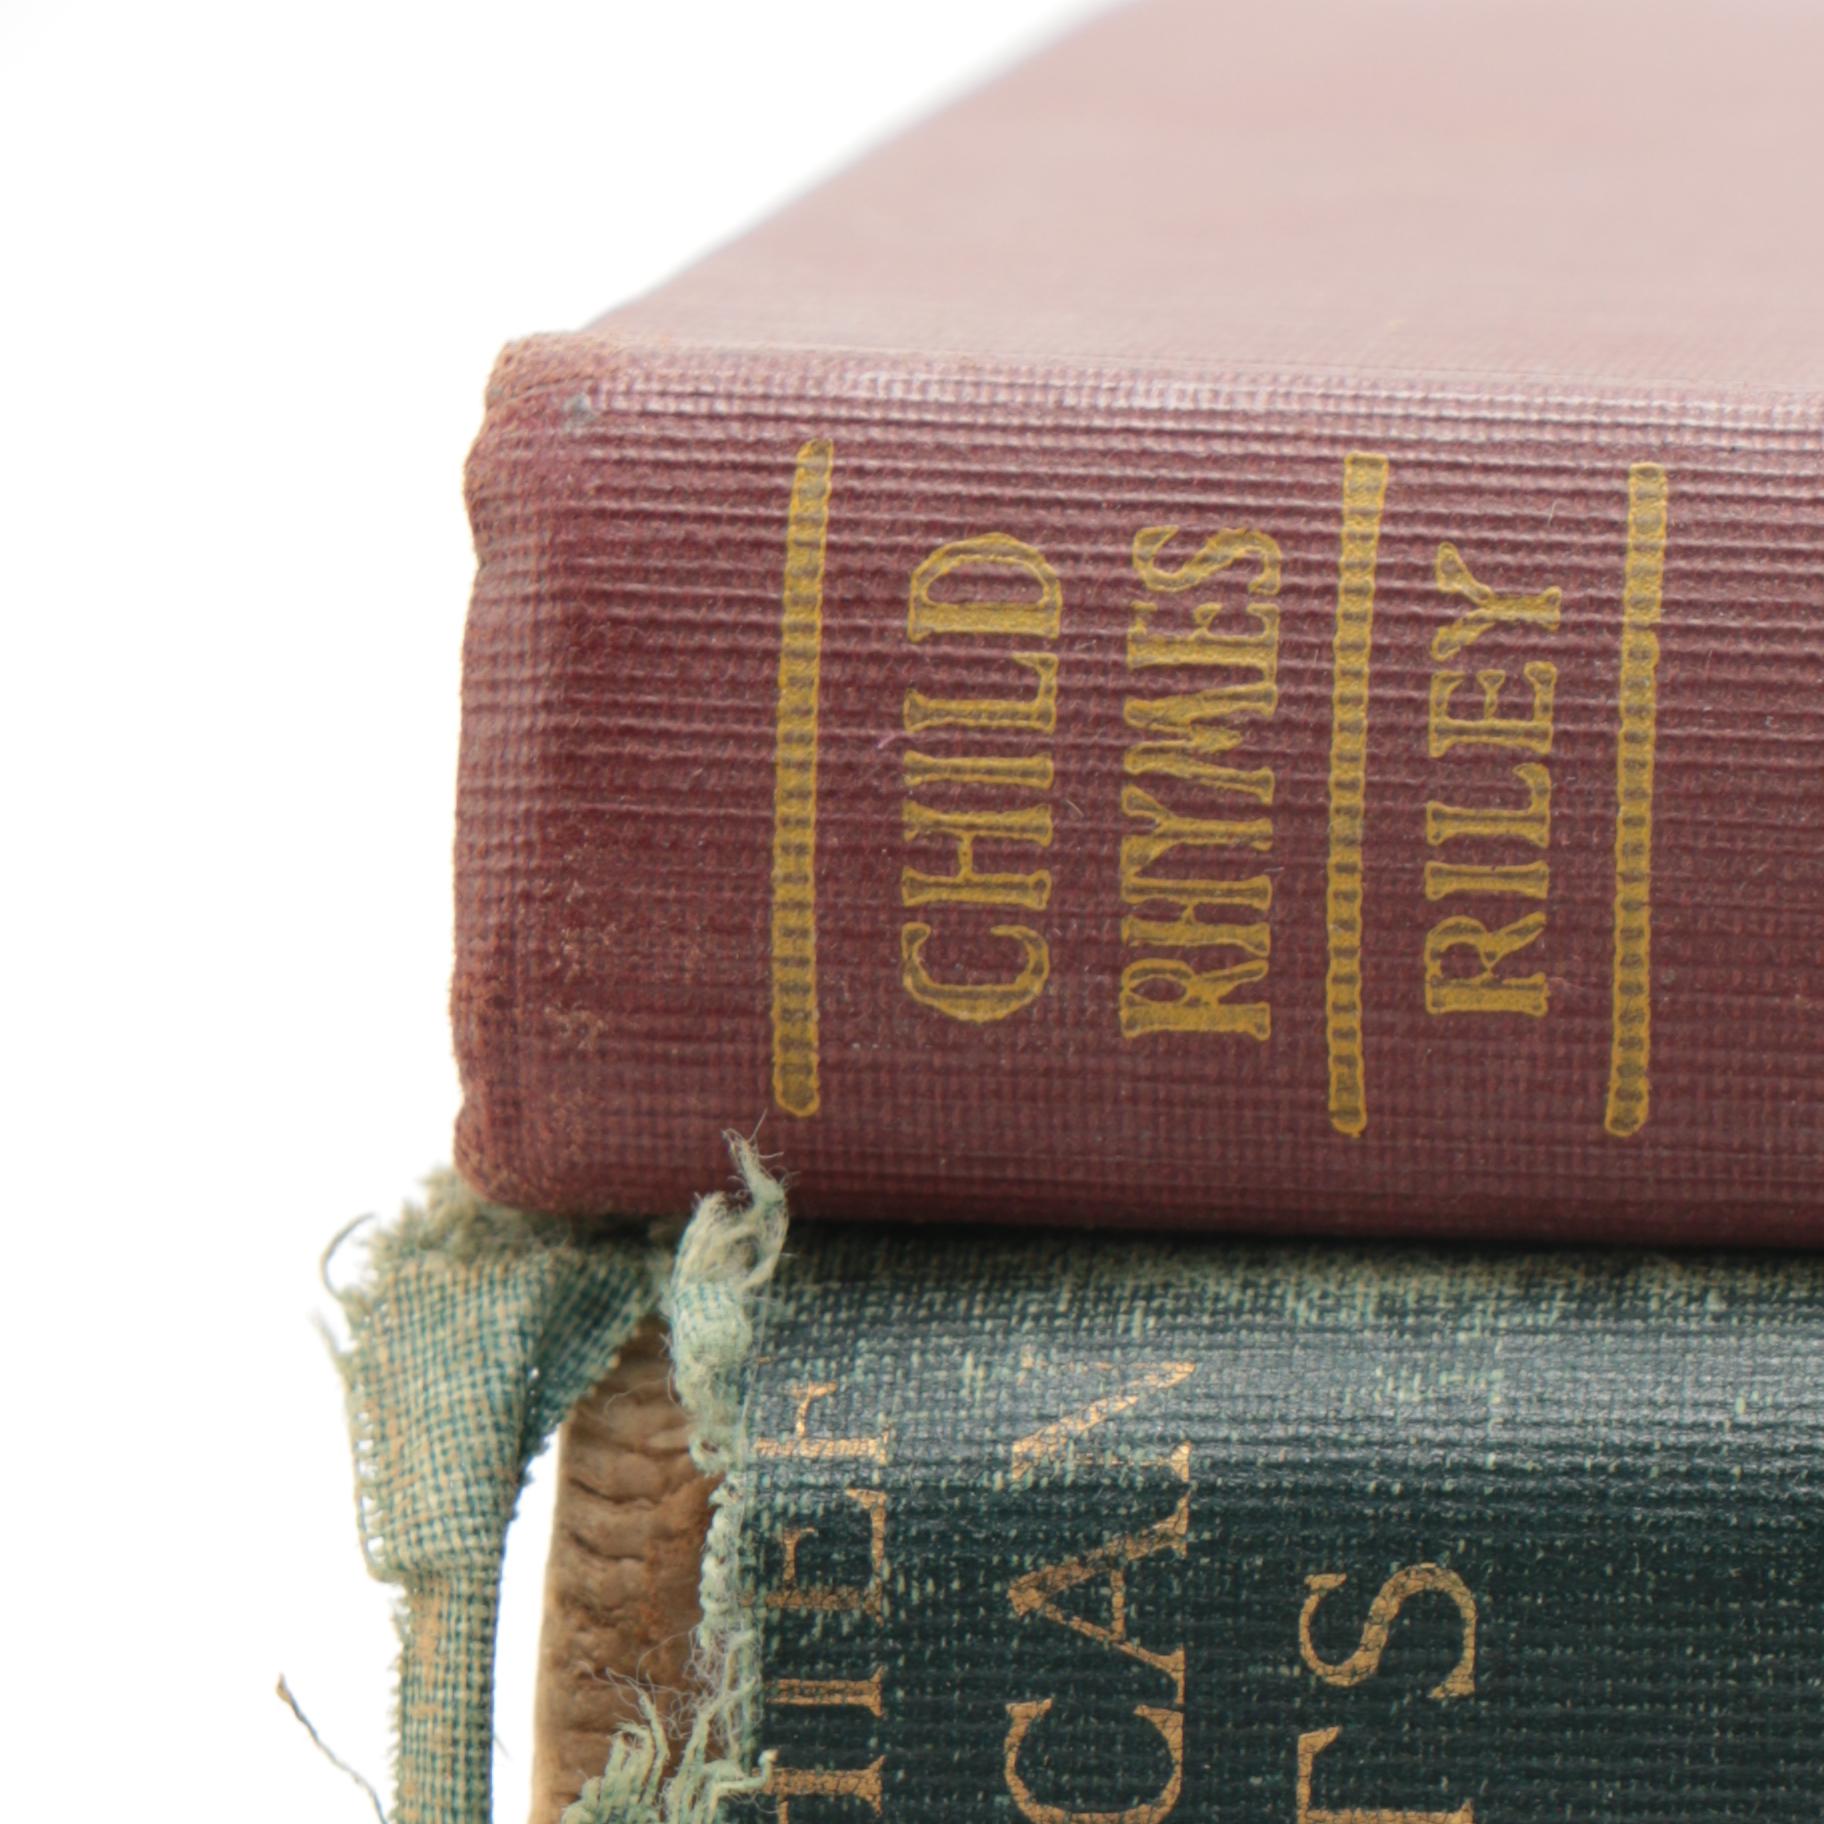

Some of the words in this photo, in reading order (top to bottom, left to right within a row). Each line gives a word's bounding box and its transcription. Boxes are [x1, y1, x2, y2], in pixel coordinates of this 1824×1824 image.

[904, 534, 1061, 1019] CHILD
[1121, 526, 1281, 1039] RHYMES
[1426, 543, 1560, 1015] RILEY
